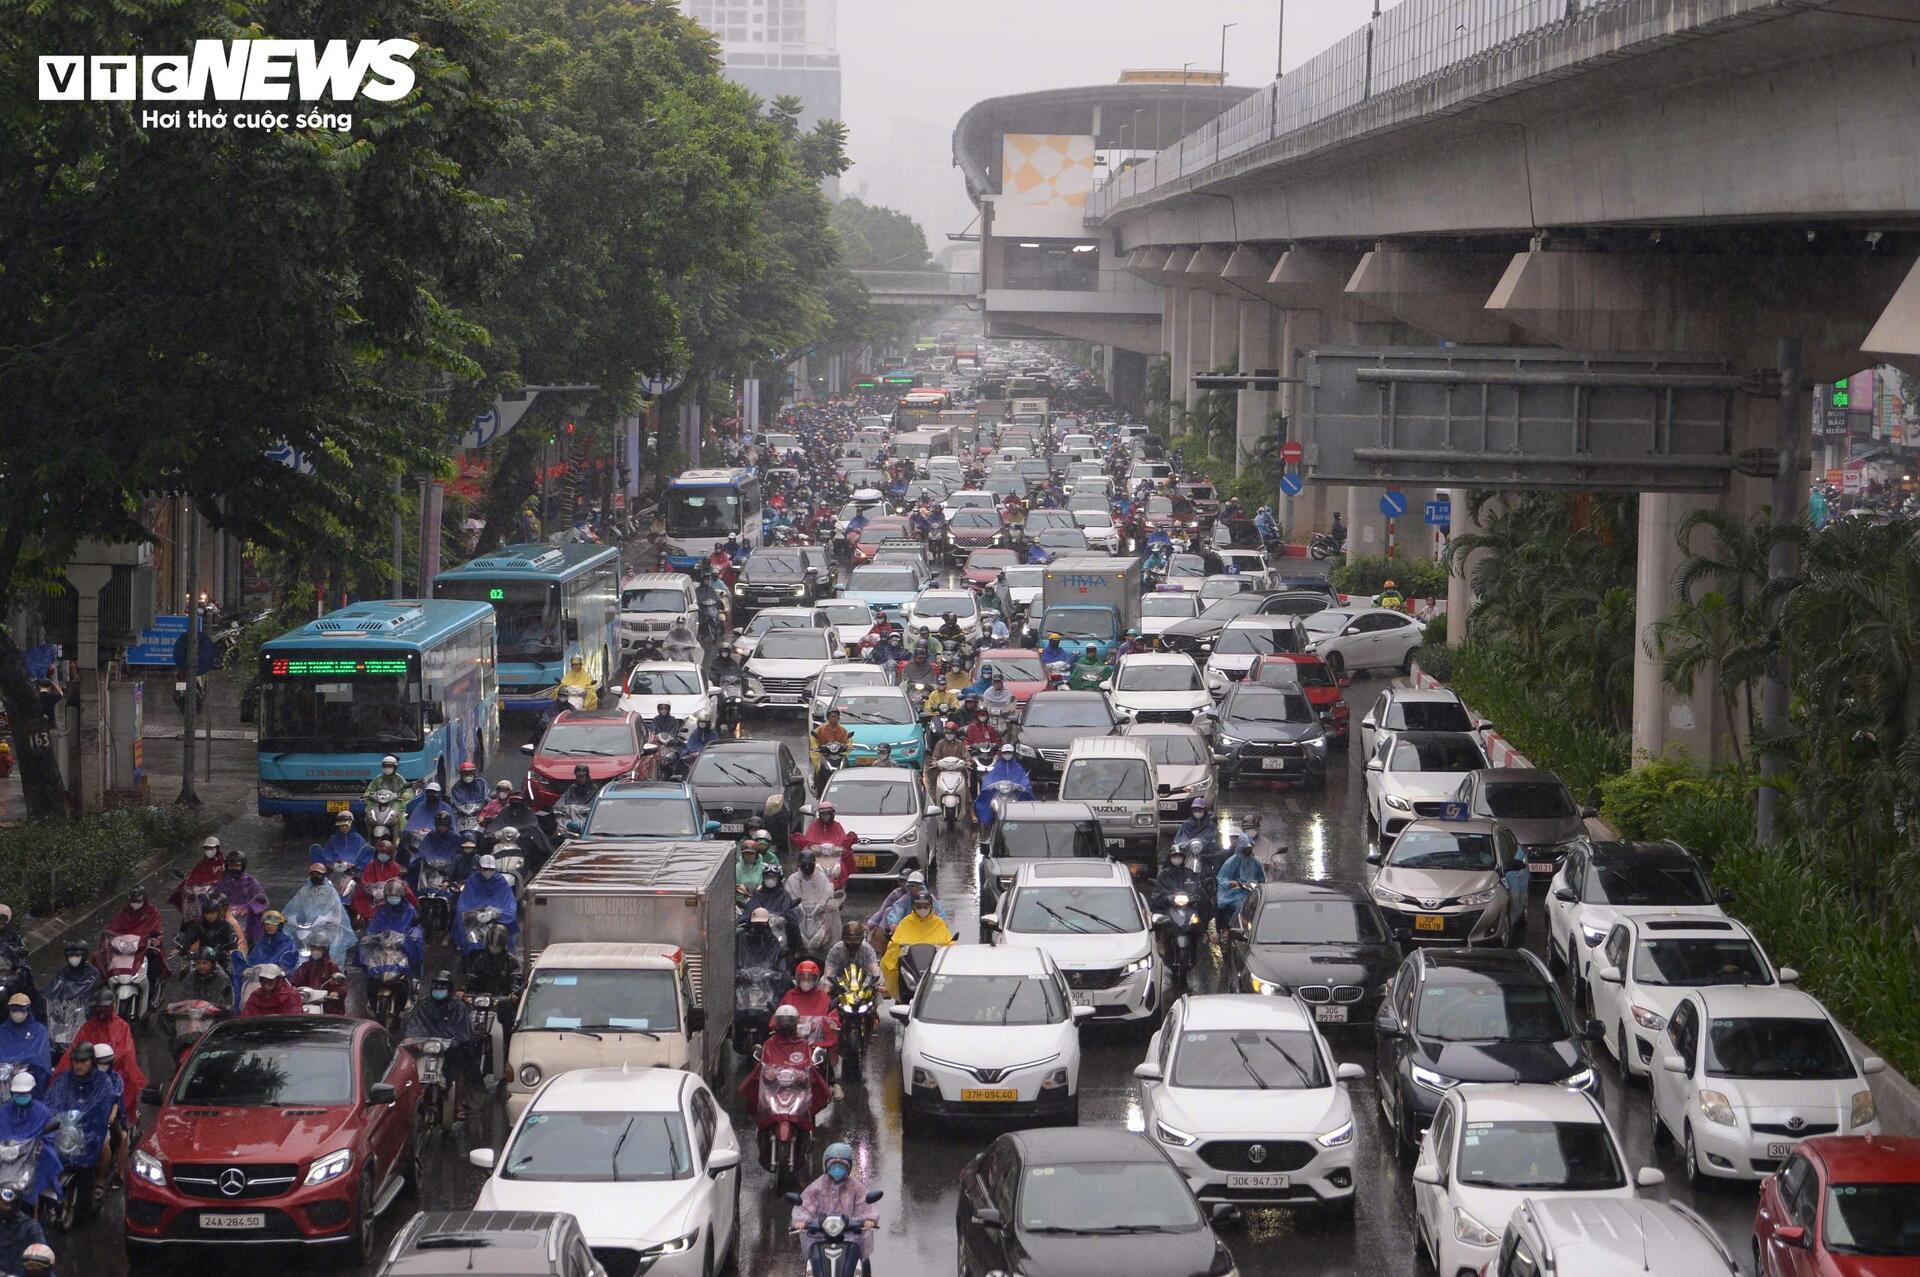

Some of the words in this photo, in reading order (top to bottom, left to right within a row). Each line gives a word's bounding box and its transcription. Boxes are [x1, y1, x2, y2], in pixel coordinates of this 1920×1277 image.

[1062, 575, 1105, 587] HMA
[490, 589, 503, 599] 02
[30, 733, 50, 747] 163
[1446, 804, 1461, 817] G7
[205, 1216, 260, 1227] 24A-284.50
